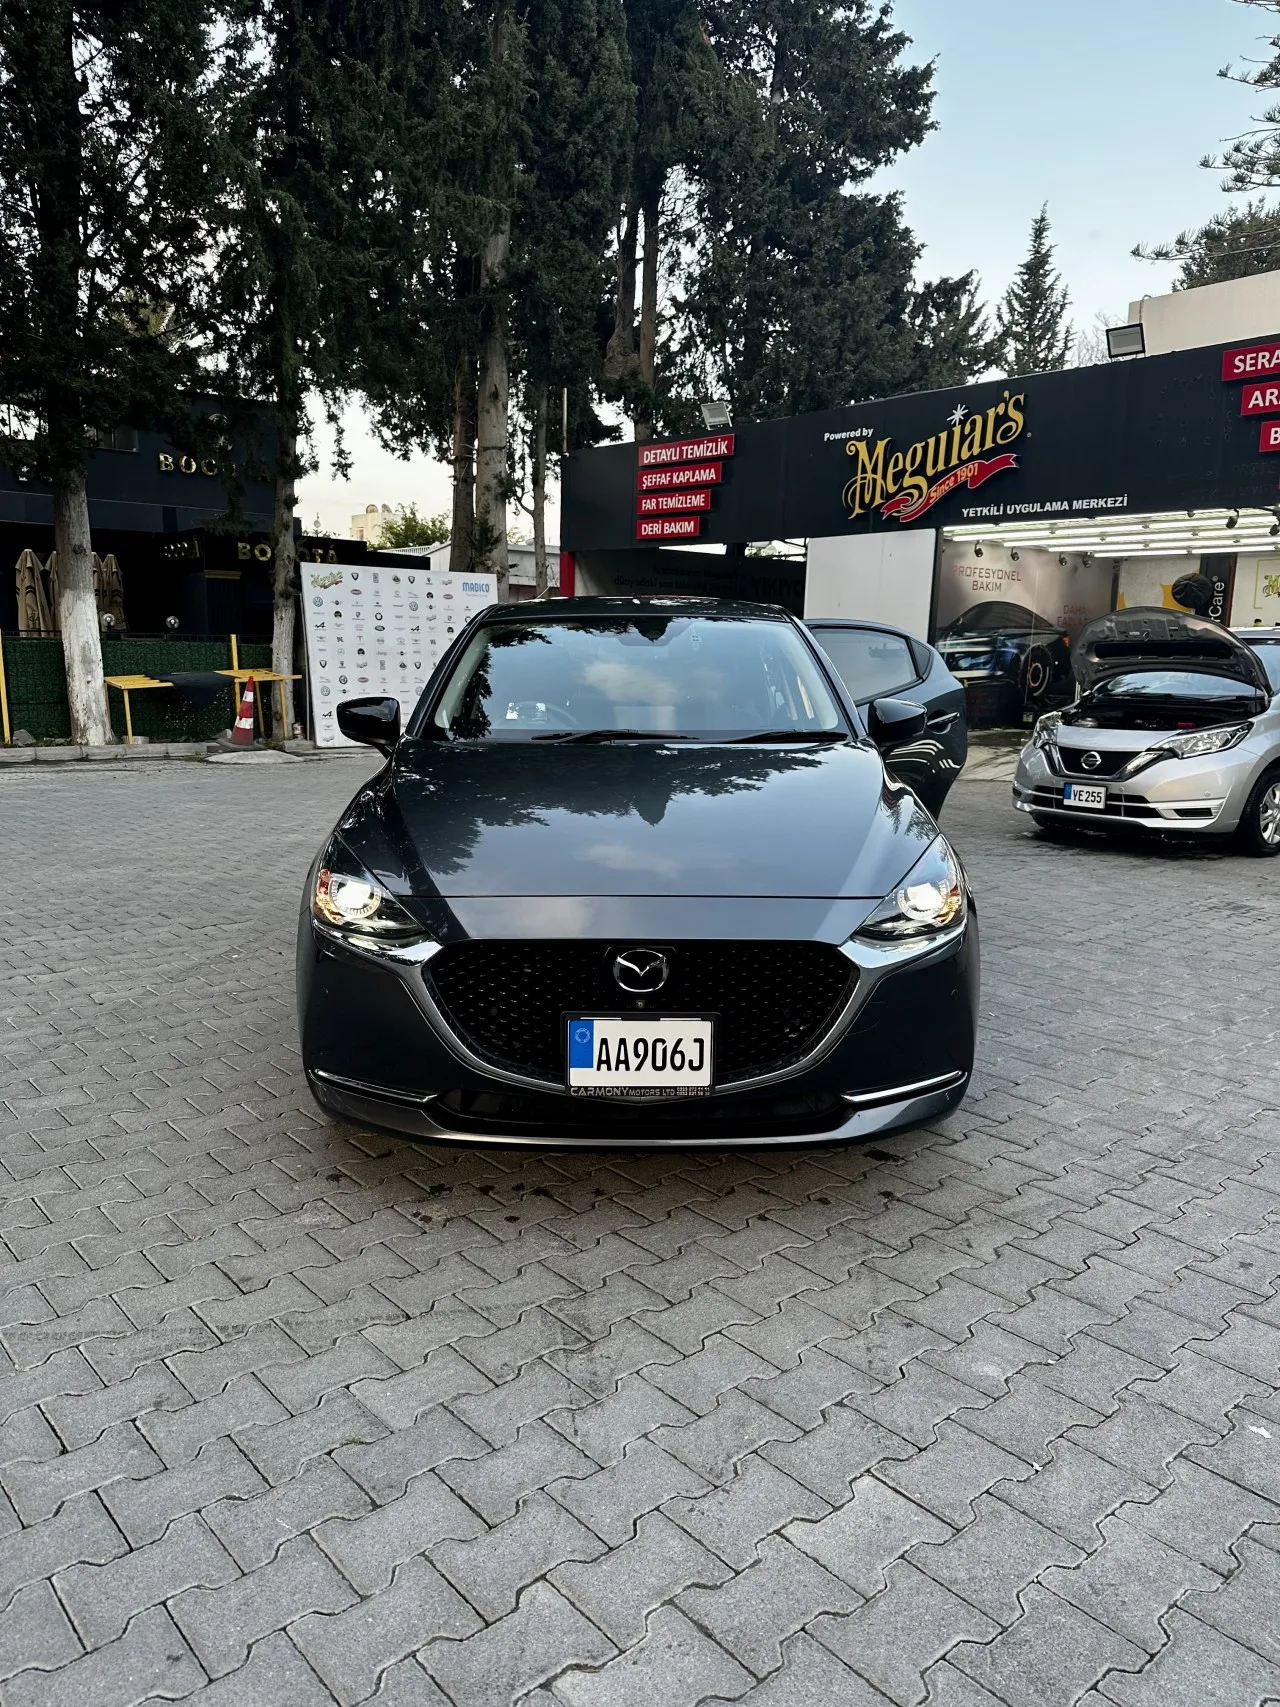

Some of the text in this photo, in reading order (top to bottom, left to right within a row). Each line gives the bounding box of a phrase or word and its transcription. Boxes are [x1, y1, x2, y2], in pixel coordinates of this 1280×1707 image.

[1248, 388, 1280, 408] AR
[824, 427, 874, 441] Powered by
[643, 438, 728, 464] DETAYLI TEMİZLİK
[842, 390, 1025, 520] Meguiar's
[642, 468, 716, 490] ŞEFFAF KAPLAMA
[929, 463, 979, 503] Since 1901
[641, 494, 705, 511] FAR TEMİZLEME
[962, 494, 1128, 517] YETKİLİ UYGULAMA MERKEZİ
[641, 521, 695, 535] DERİ BAKIM
[952, 565, 1022, 581] PROFESYONEL
[462, 582, 490, 593] MADICO
[972, 580, 1002, 592] BAKIM
[596, 1037, 705, 1071] AA906J
